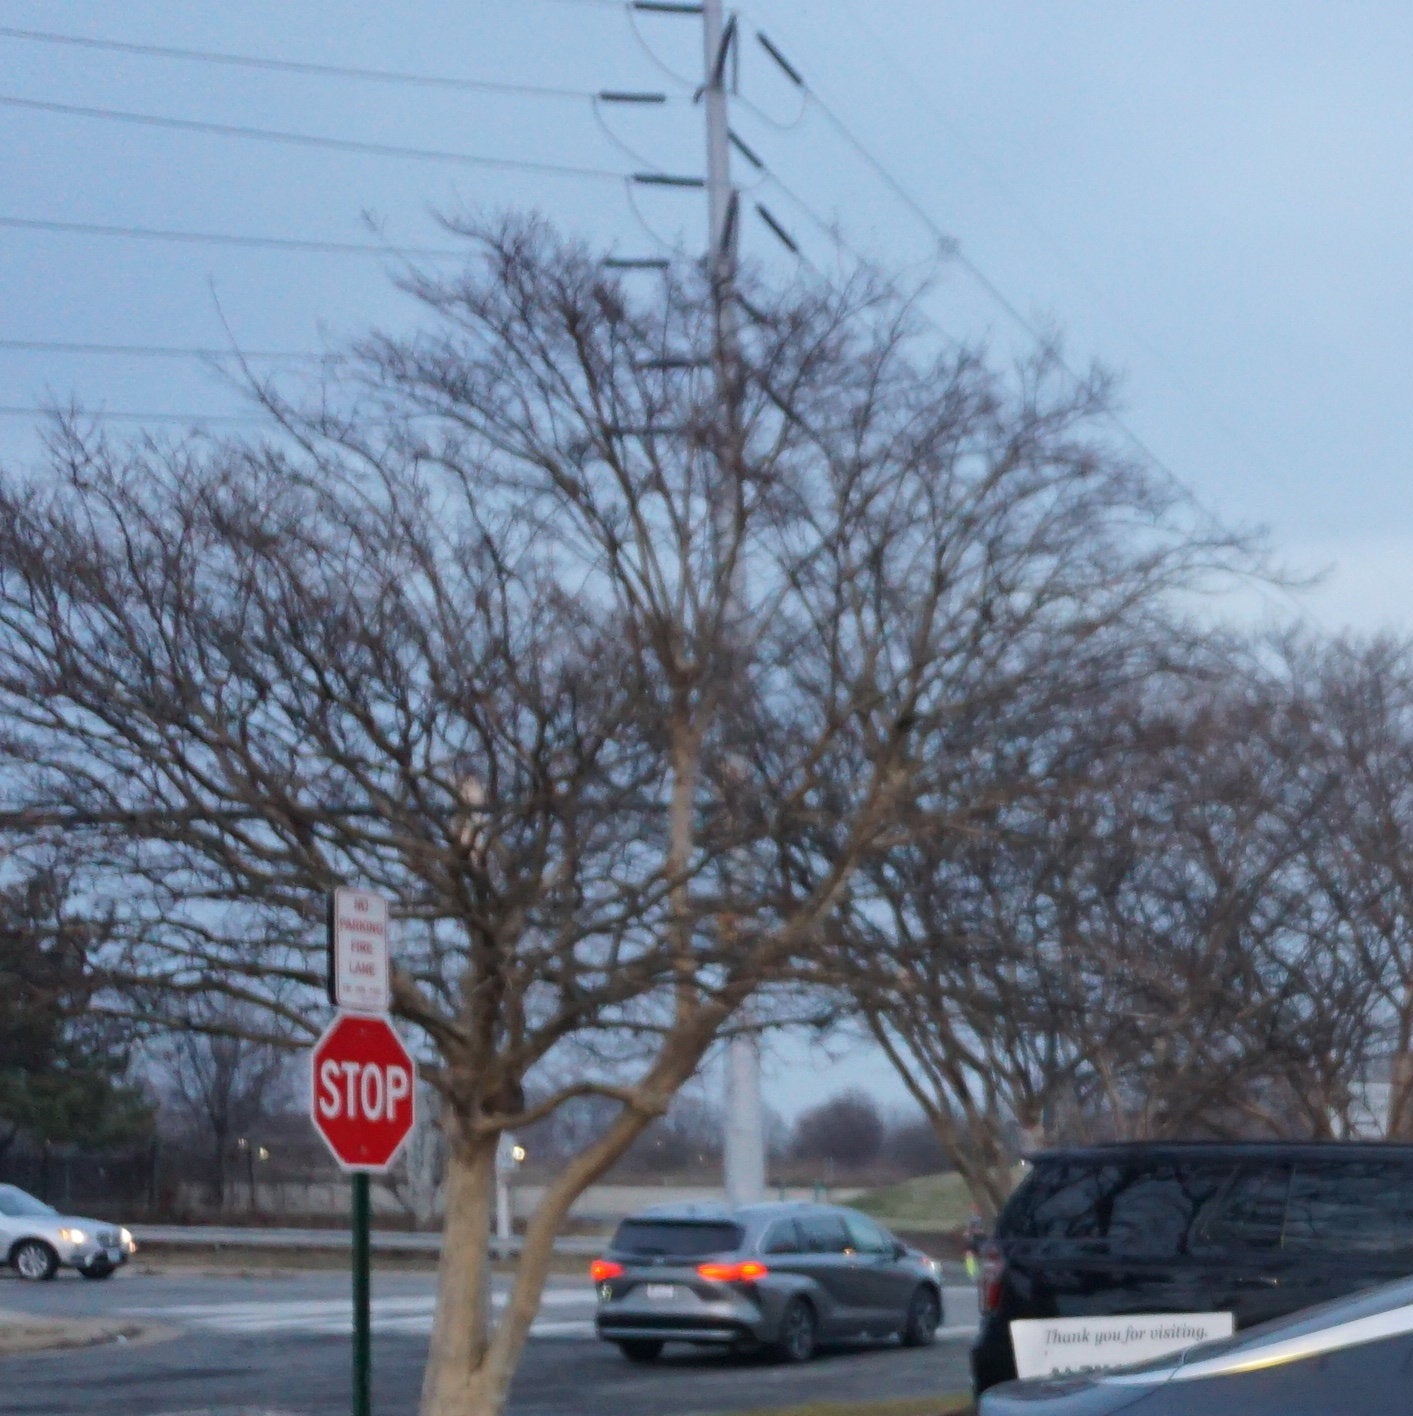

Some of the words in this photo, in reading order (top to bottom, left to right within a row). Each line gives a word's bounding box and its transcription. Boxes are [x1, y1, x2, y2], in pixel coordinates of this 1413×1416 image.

[340, 918, 384, 935] PARKING
[351, 940, 373, 954] FIRE
[348, 959, 376, 977] LANE
[319, 1058, 408, 1121] STOP
[1046, 1327, 1091, 1345] Thank
[1094, 1331, 1121, 1346] you
[1121, 1325, 1146, 1344] for
